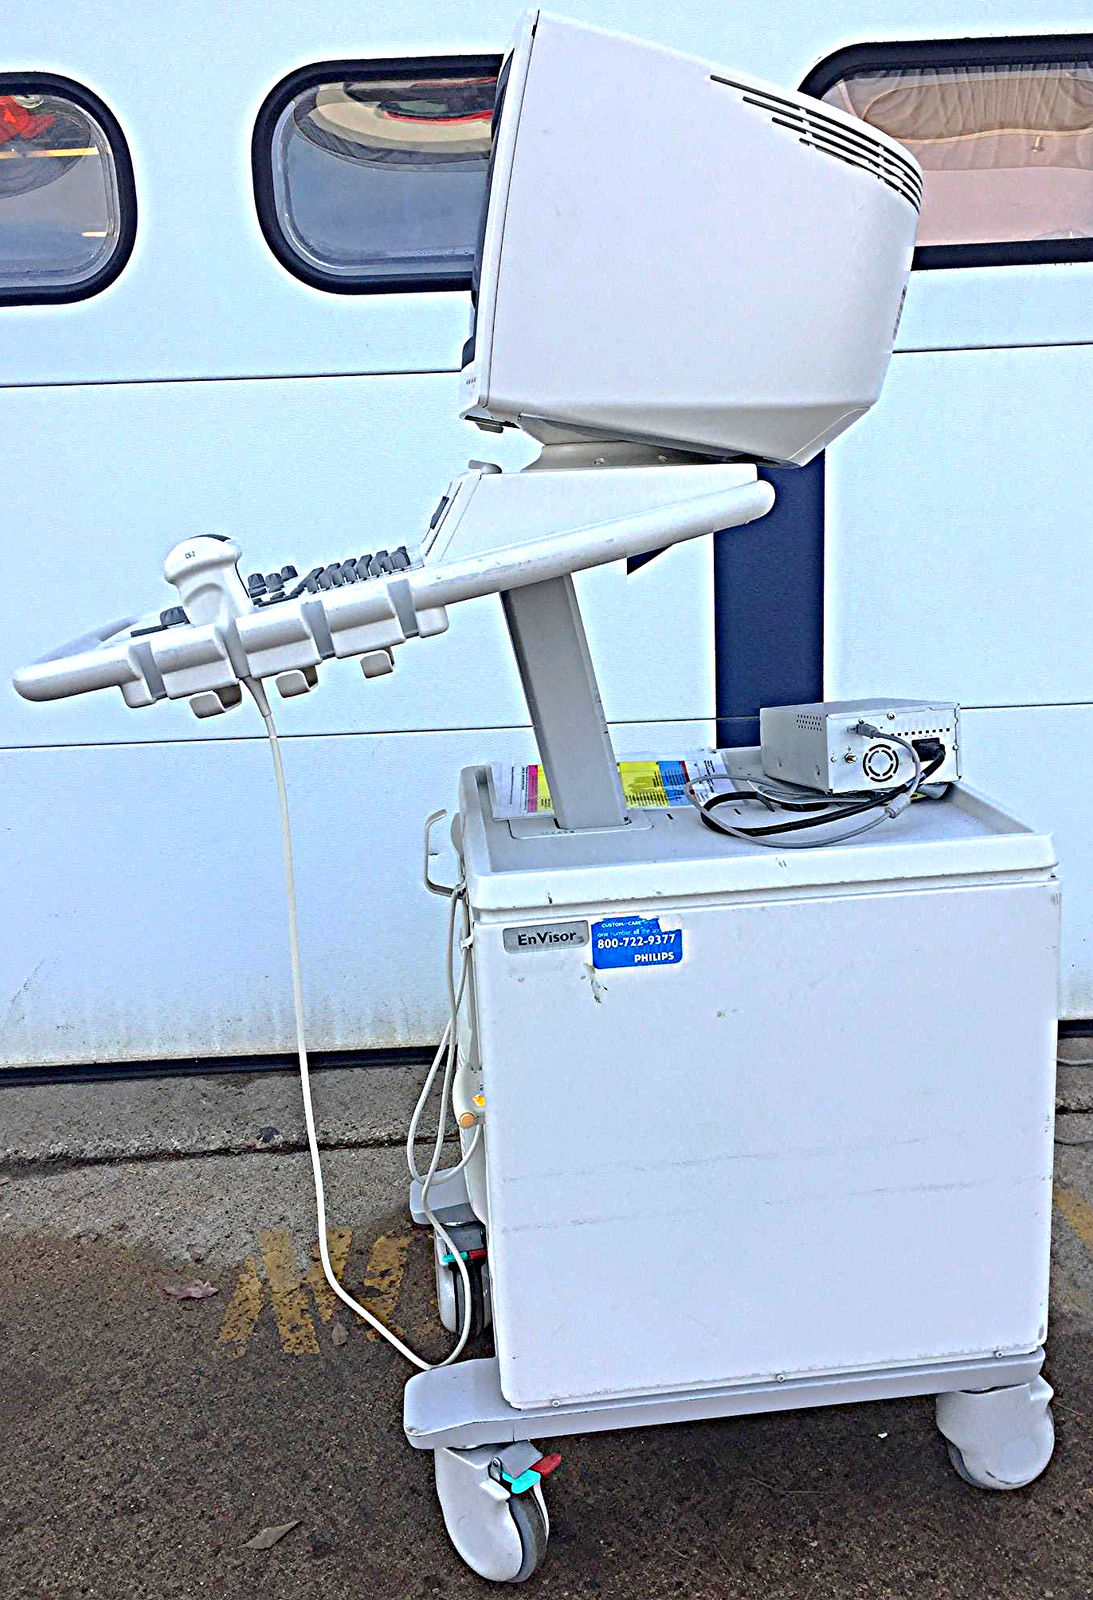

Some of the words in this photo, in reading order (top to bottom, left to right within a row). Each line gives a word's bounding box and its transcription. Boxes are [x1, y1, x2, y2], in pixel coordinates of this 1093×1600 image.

[517, 930, 577, 946] EnVisor
[597, 933, 676, 950] 800-722-9377
[634, 951, 675, 963] PHILIPS
